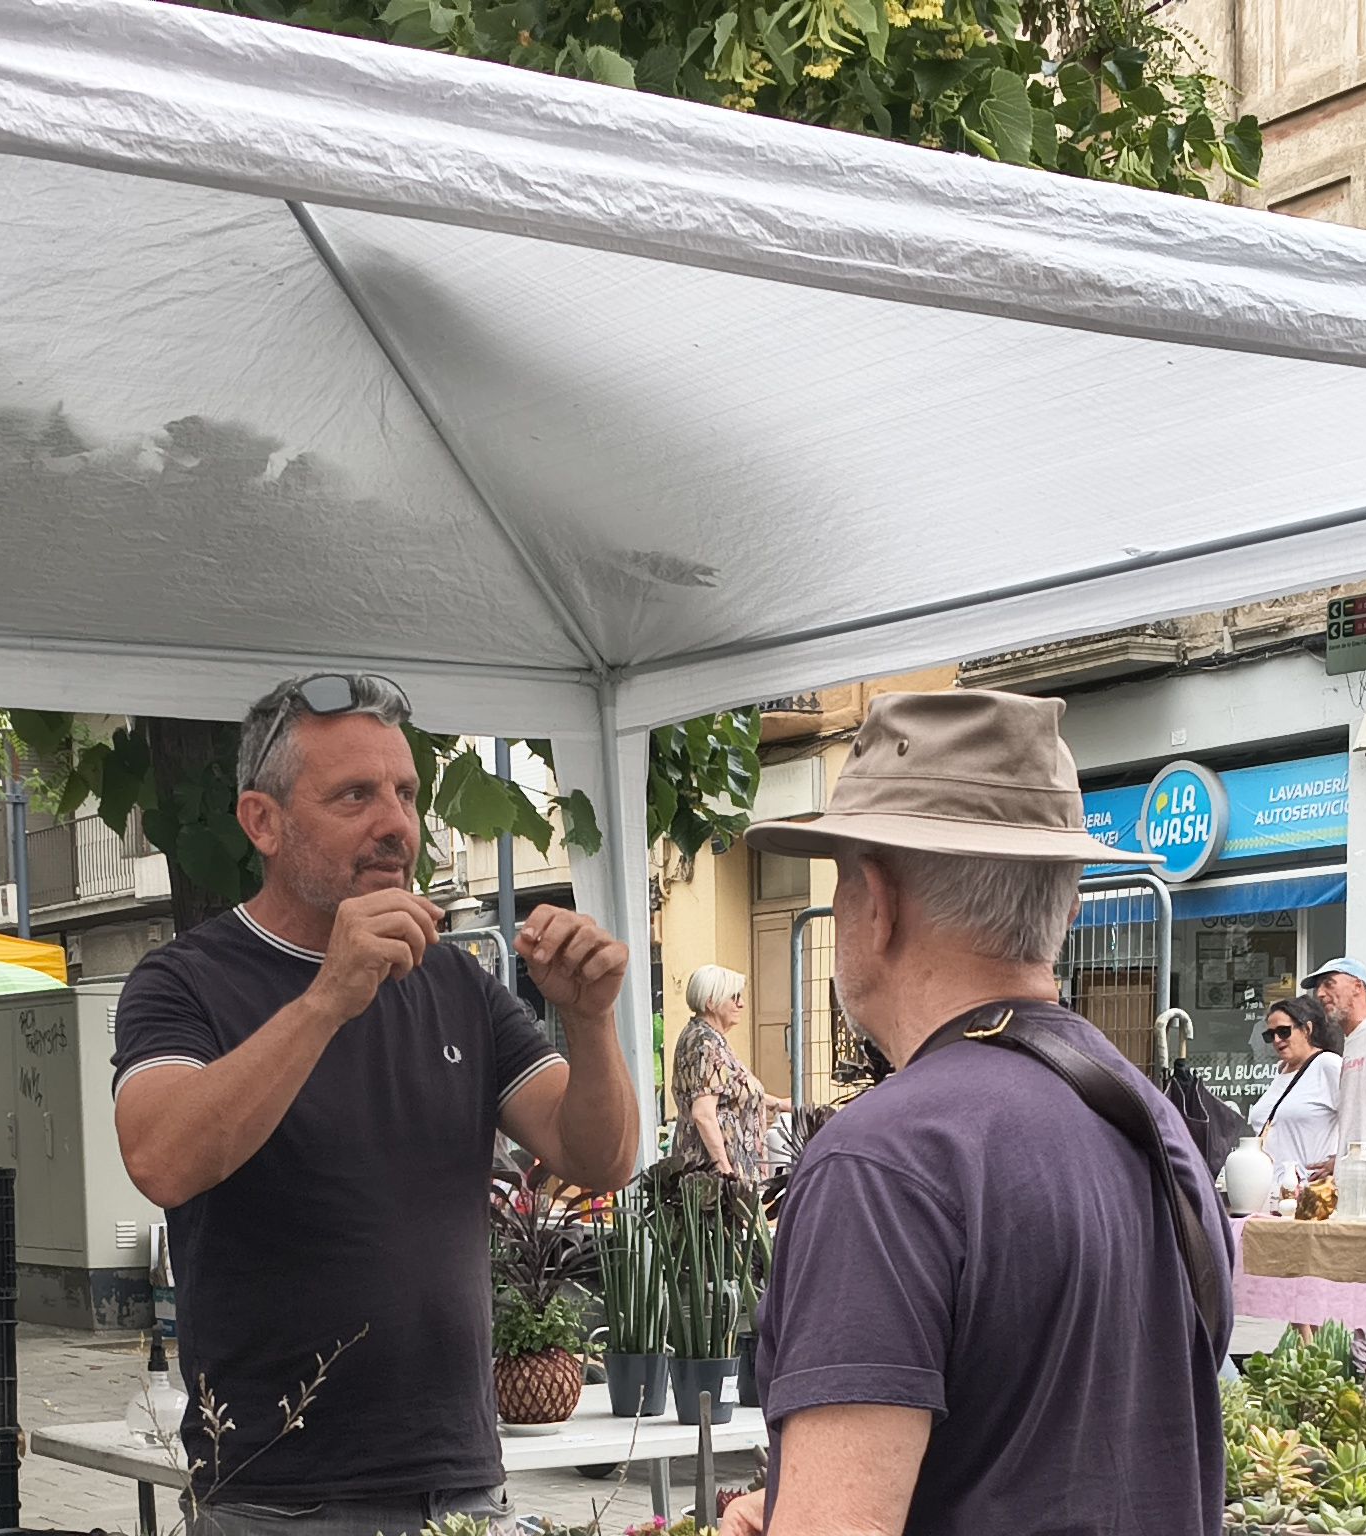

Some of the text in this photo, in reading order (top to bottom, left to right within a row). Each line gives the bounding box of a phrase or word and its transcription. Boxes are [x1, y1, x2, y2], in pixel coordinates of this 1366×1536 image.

[1170, 783, 1197, 815] LA
[1148, 812, 1211, 850] WASH
[1214, 1064, 1232, 1081] LA
[1229, 1083, 1243, 1097] LA
